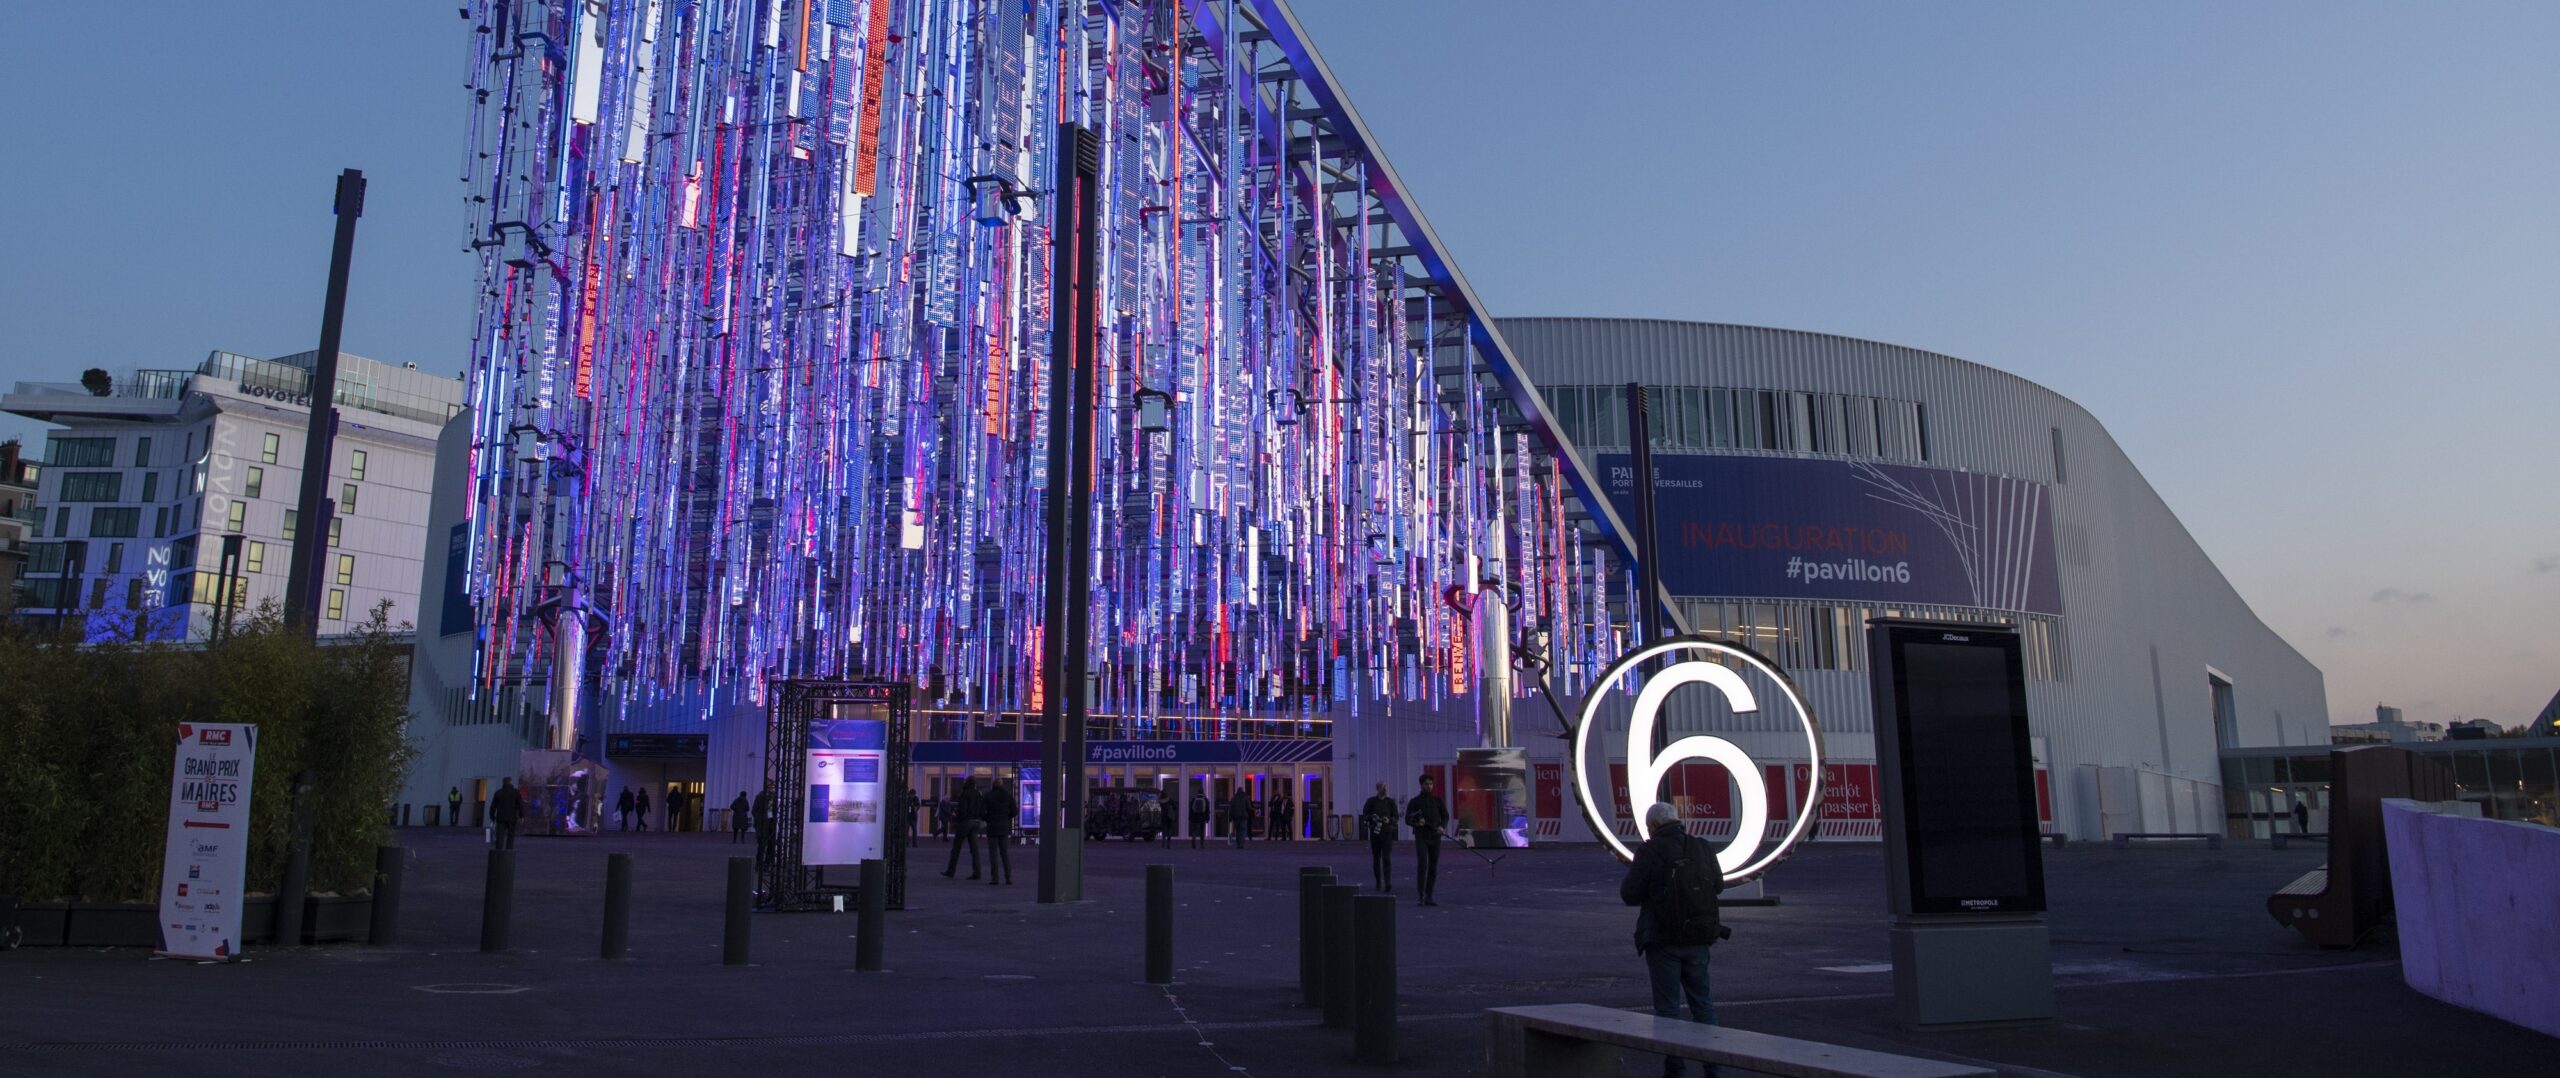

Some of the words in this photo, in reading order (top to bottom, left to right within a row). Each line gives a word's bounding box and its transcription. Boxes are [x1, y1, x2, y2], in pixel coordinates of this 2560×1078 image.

[858, 45, 886, 180] WELCOME
[1654, 479, 1704, 488] VERSAILLES
[1681, 521, 1909, 556] INAUGURATION
[1786, 555, 1911, 585] #pavillon6
[205, 730, 227, 741] RMC
[1091, 744, 1177, 763] #pavillon6
[184, 757, 217, 776] GRAND
[218, 758, 241, 777] PRIX
[1627, 660, 1768, 876] 6
[181, 782, 238, 803] MAIRES
[1823, 801, 1868, 816] passer
